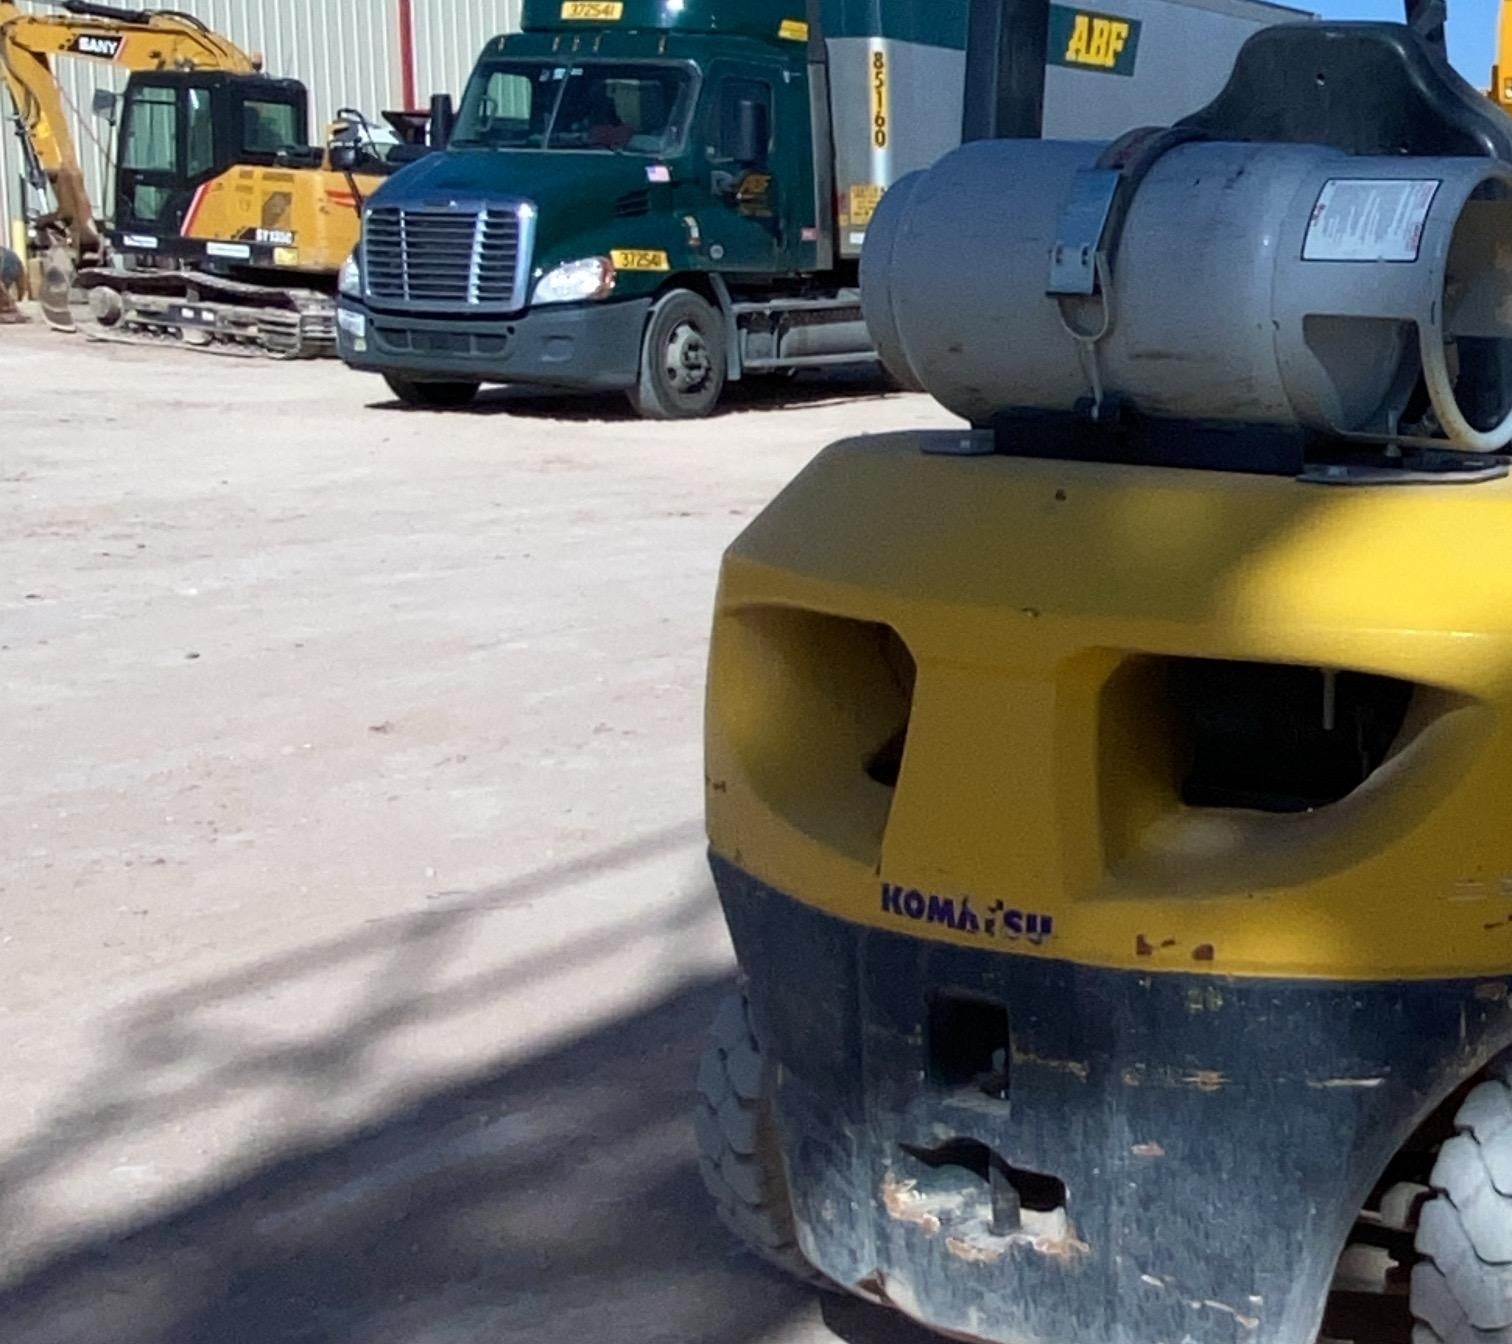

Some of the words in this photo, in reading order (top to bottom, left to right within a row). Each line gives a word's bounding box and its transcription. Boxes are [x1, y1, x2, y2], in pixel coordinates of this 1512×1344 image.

[79, 36, 118, 55] SANY
[1065, 14, 1129, 68] ABF
[873, 51, 886, 148] 85160
